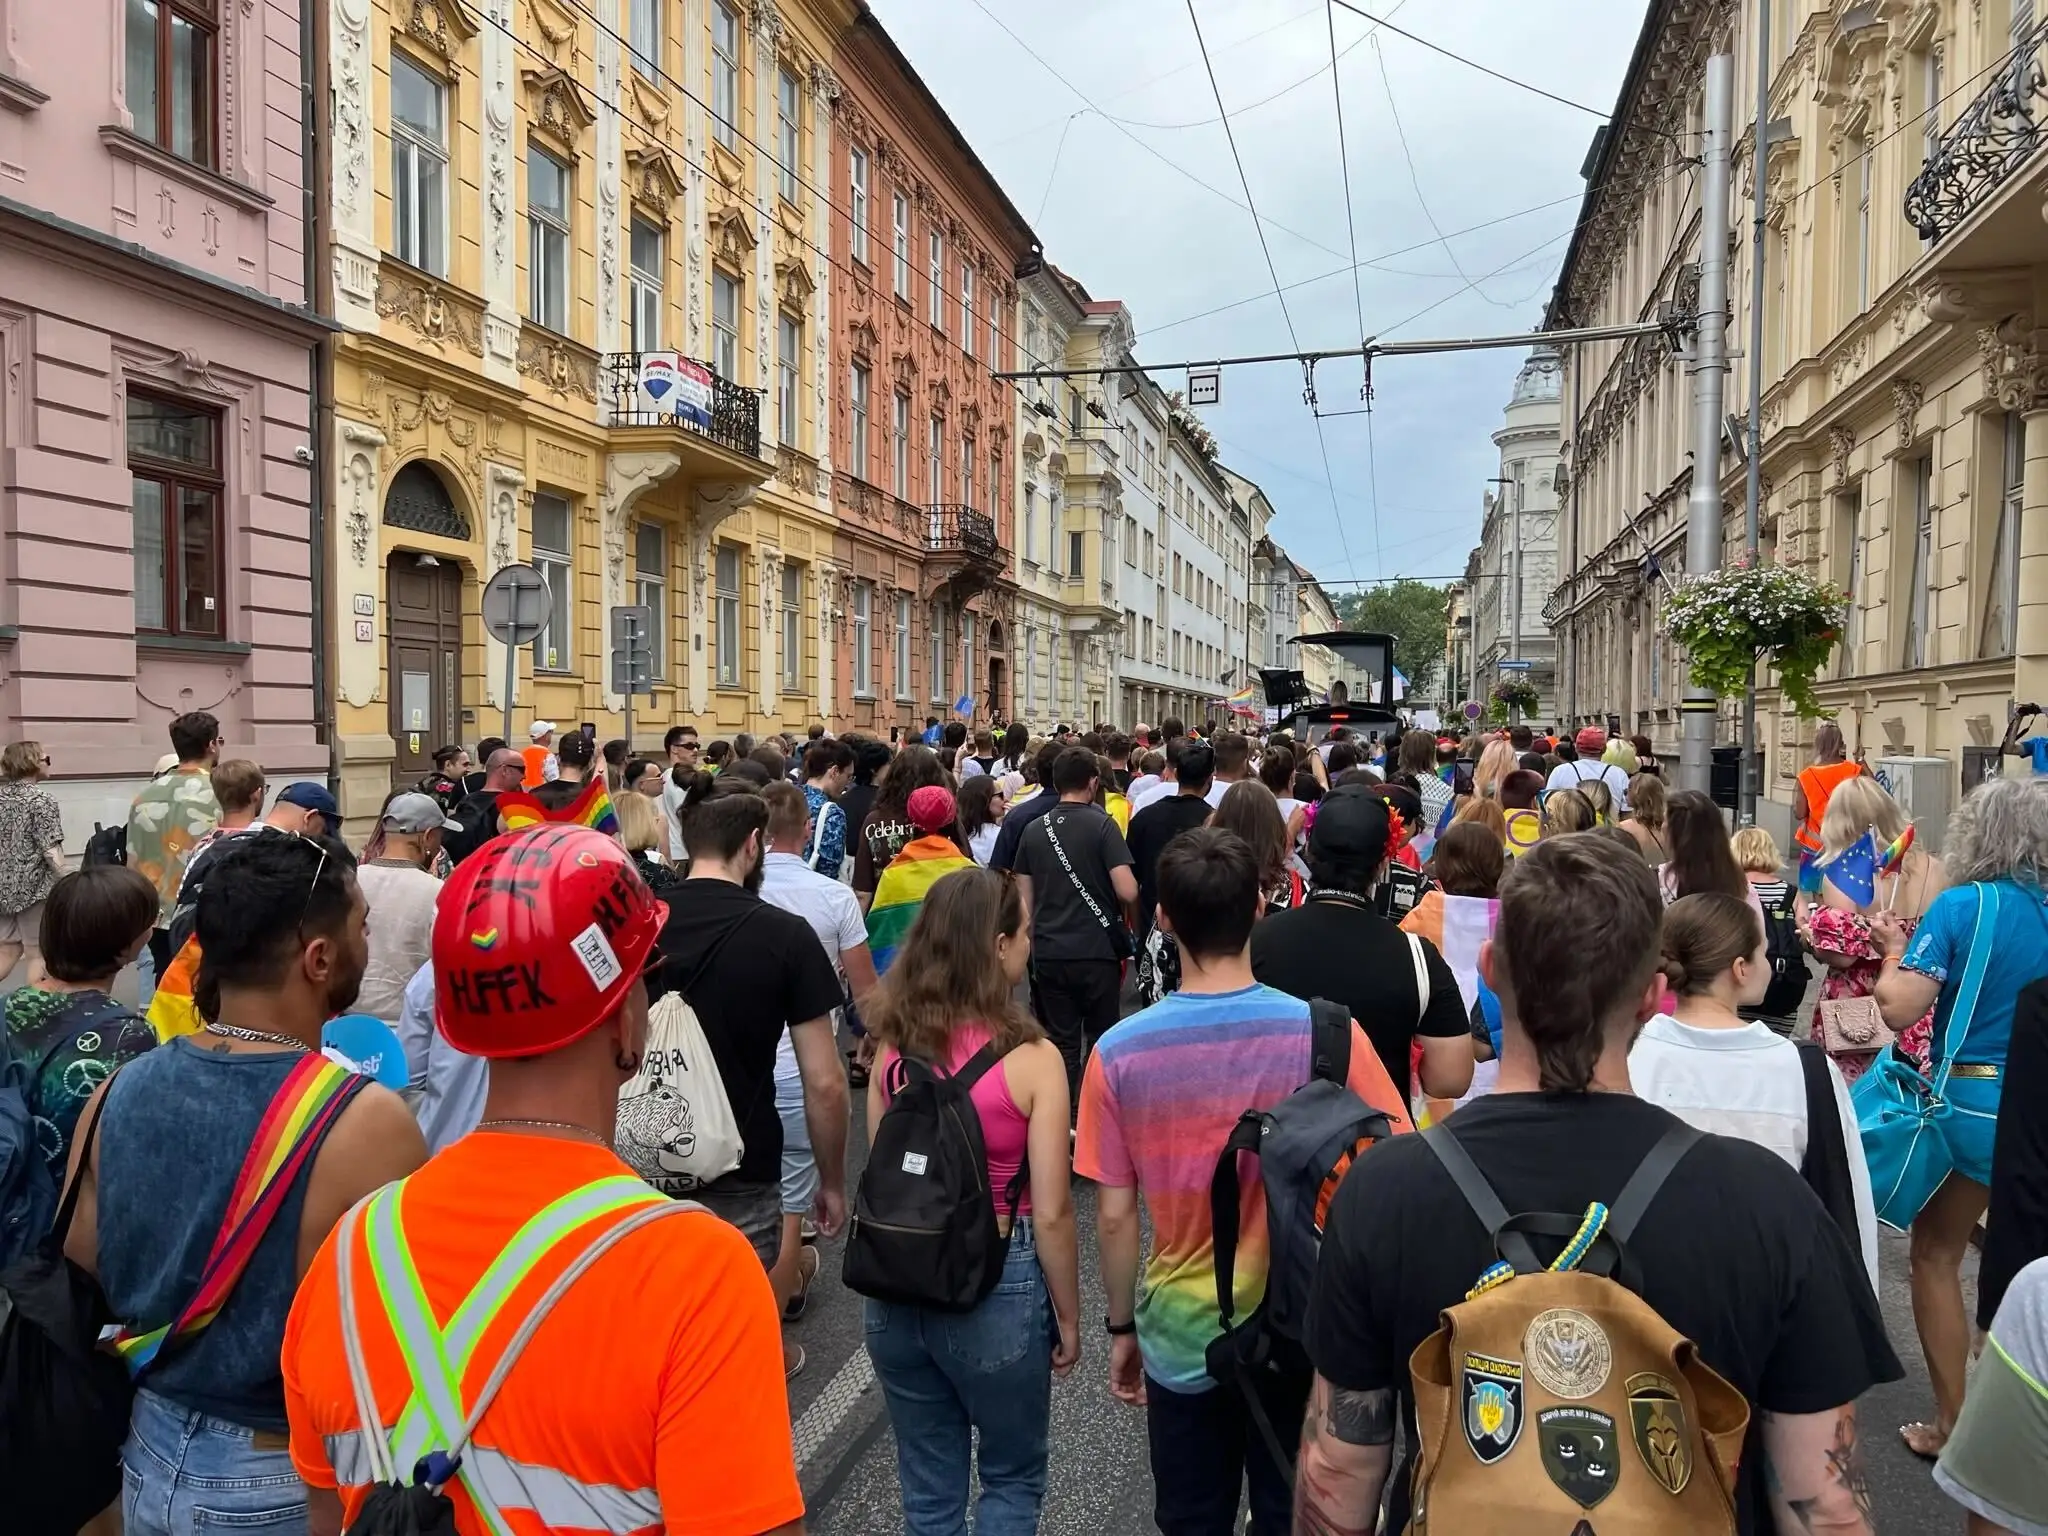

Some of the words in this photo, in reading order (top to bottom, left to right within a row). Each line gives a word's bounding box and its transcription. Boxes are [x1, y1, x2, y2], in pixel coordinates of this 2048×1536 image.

[646, 370, 671, 378] RE/MAX
[1046, 826, 1072, 872] GOEXPLORE
[1069, 871, 1102, 916] GOEXPLORE
[1316, 888, 1366, 903] audio-technica
